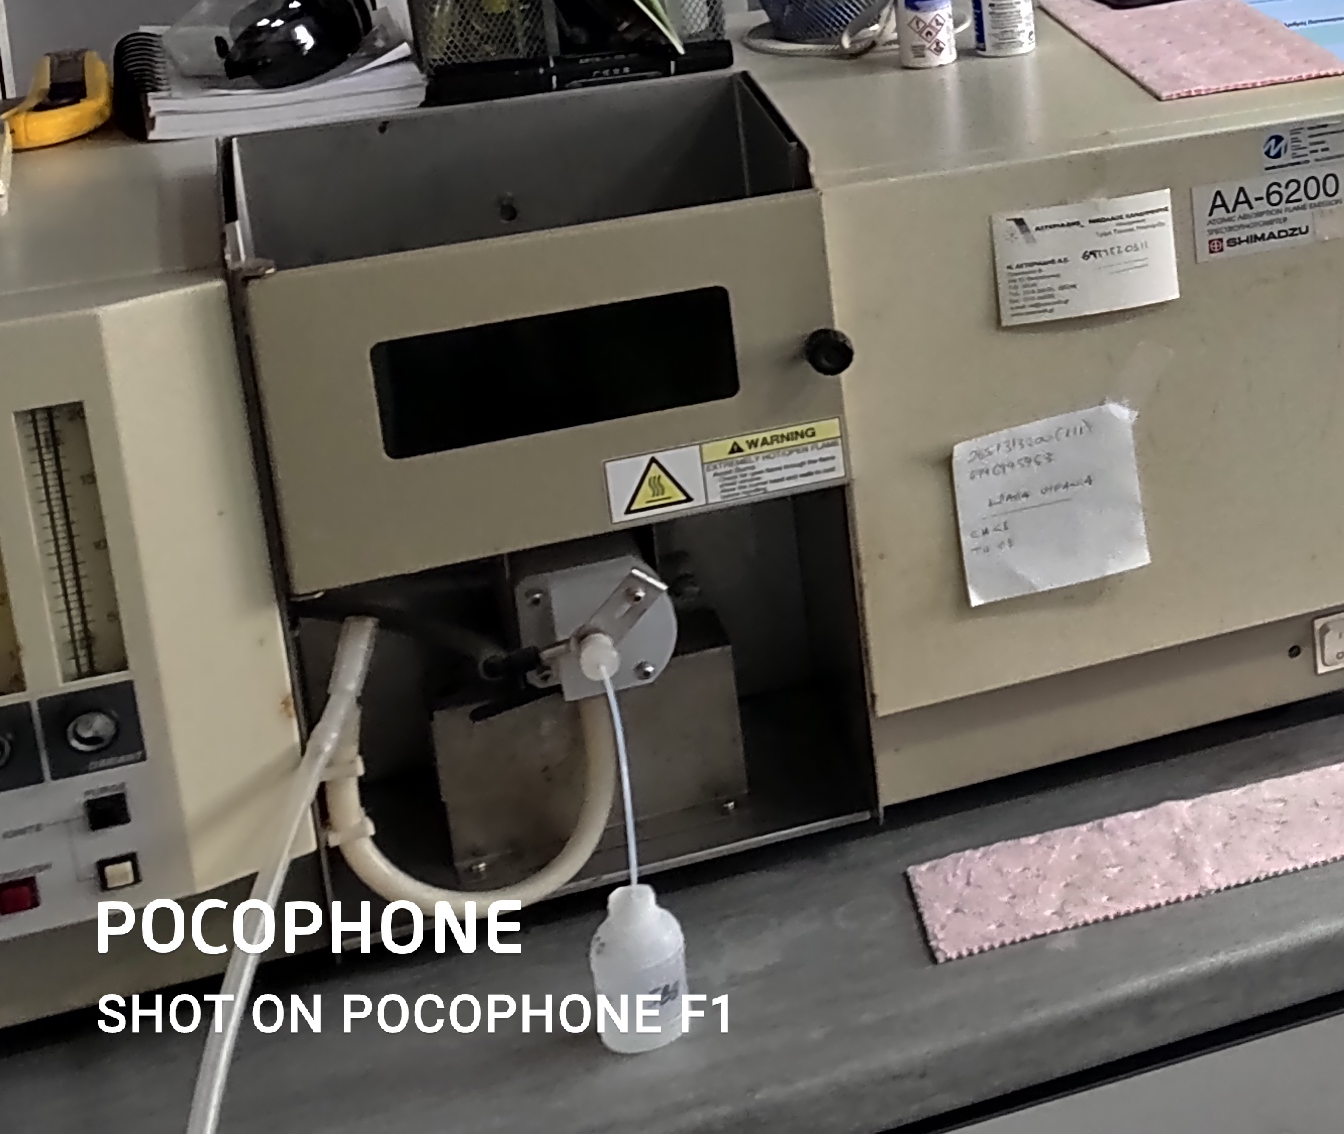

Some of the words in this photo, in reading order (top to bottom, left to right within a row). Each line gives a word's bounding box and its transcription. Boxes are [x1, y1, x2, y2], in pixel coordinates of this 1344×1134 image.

[1208, 172, 1340, 217] AA-6200
[1206, 214, 1237, 227] ATOMIC
[1284, 204, 1308, 214] FLAME
[1226, 224, 1310, 247] SHIMADZU
[745, 426, 817, 451] WARNING
[705, 455, 762, 472] EXTREMELY
